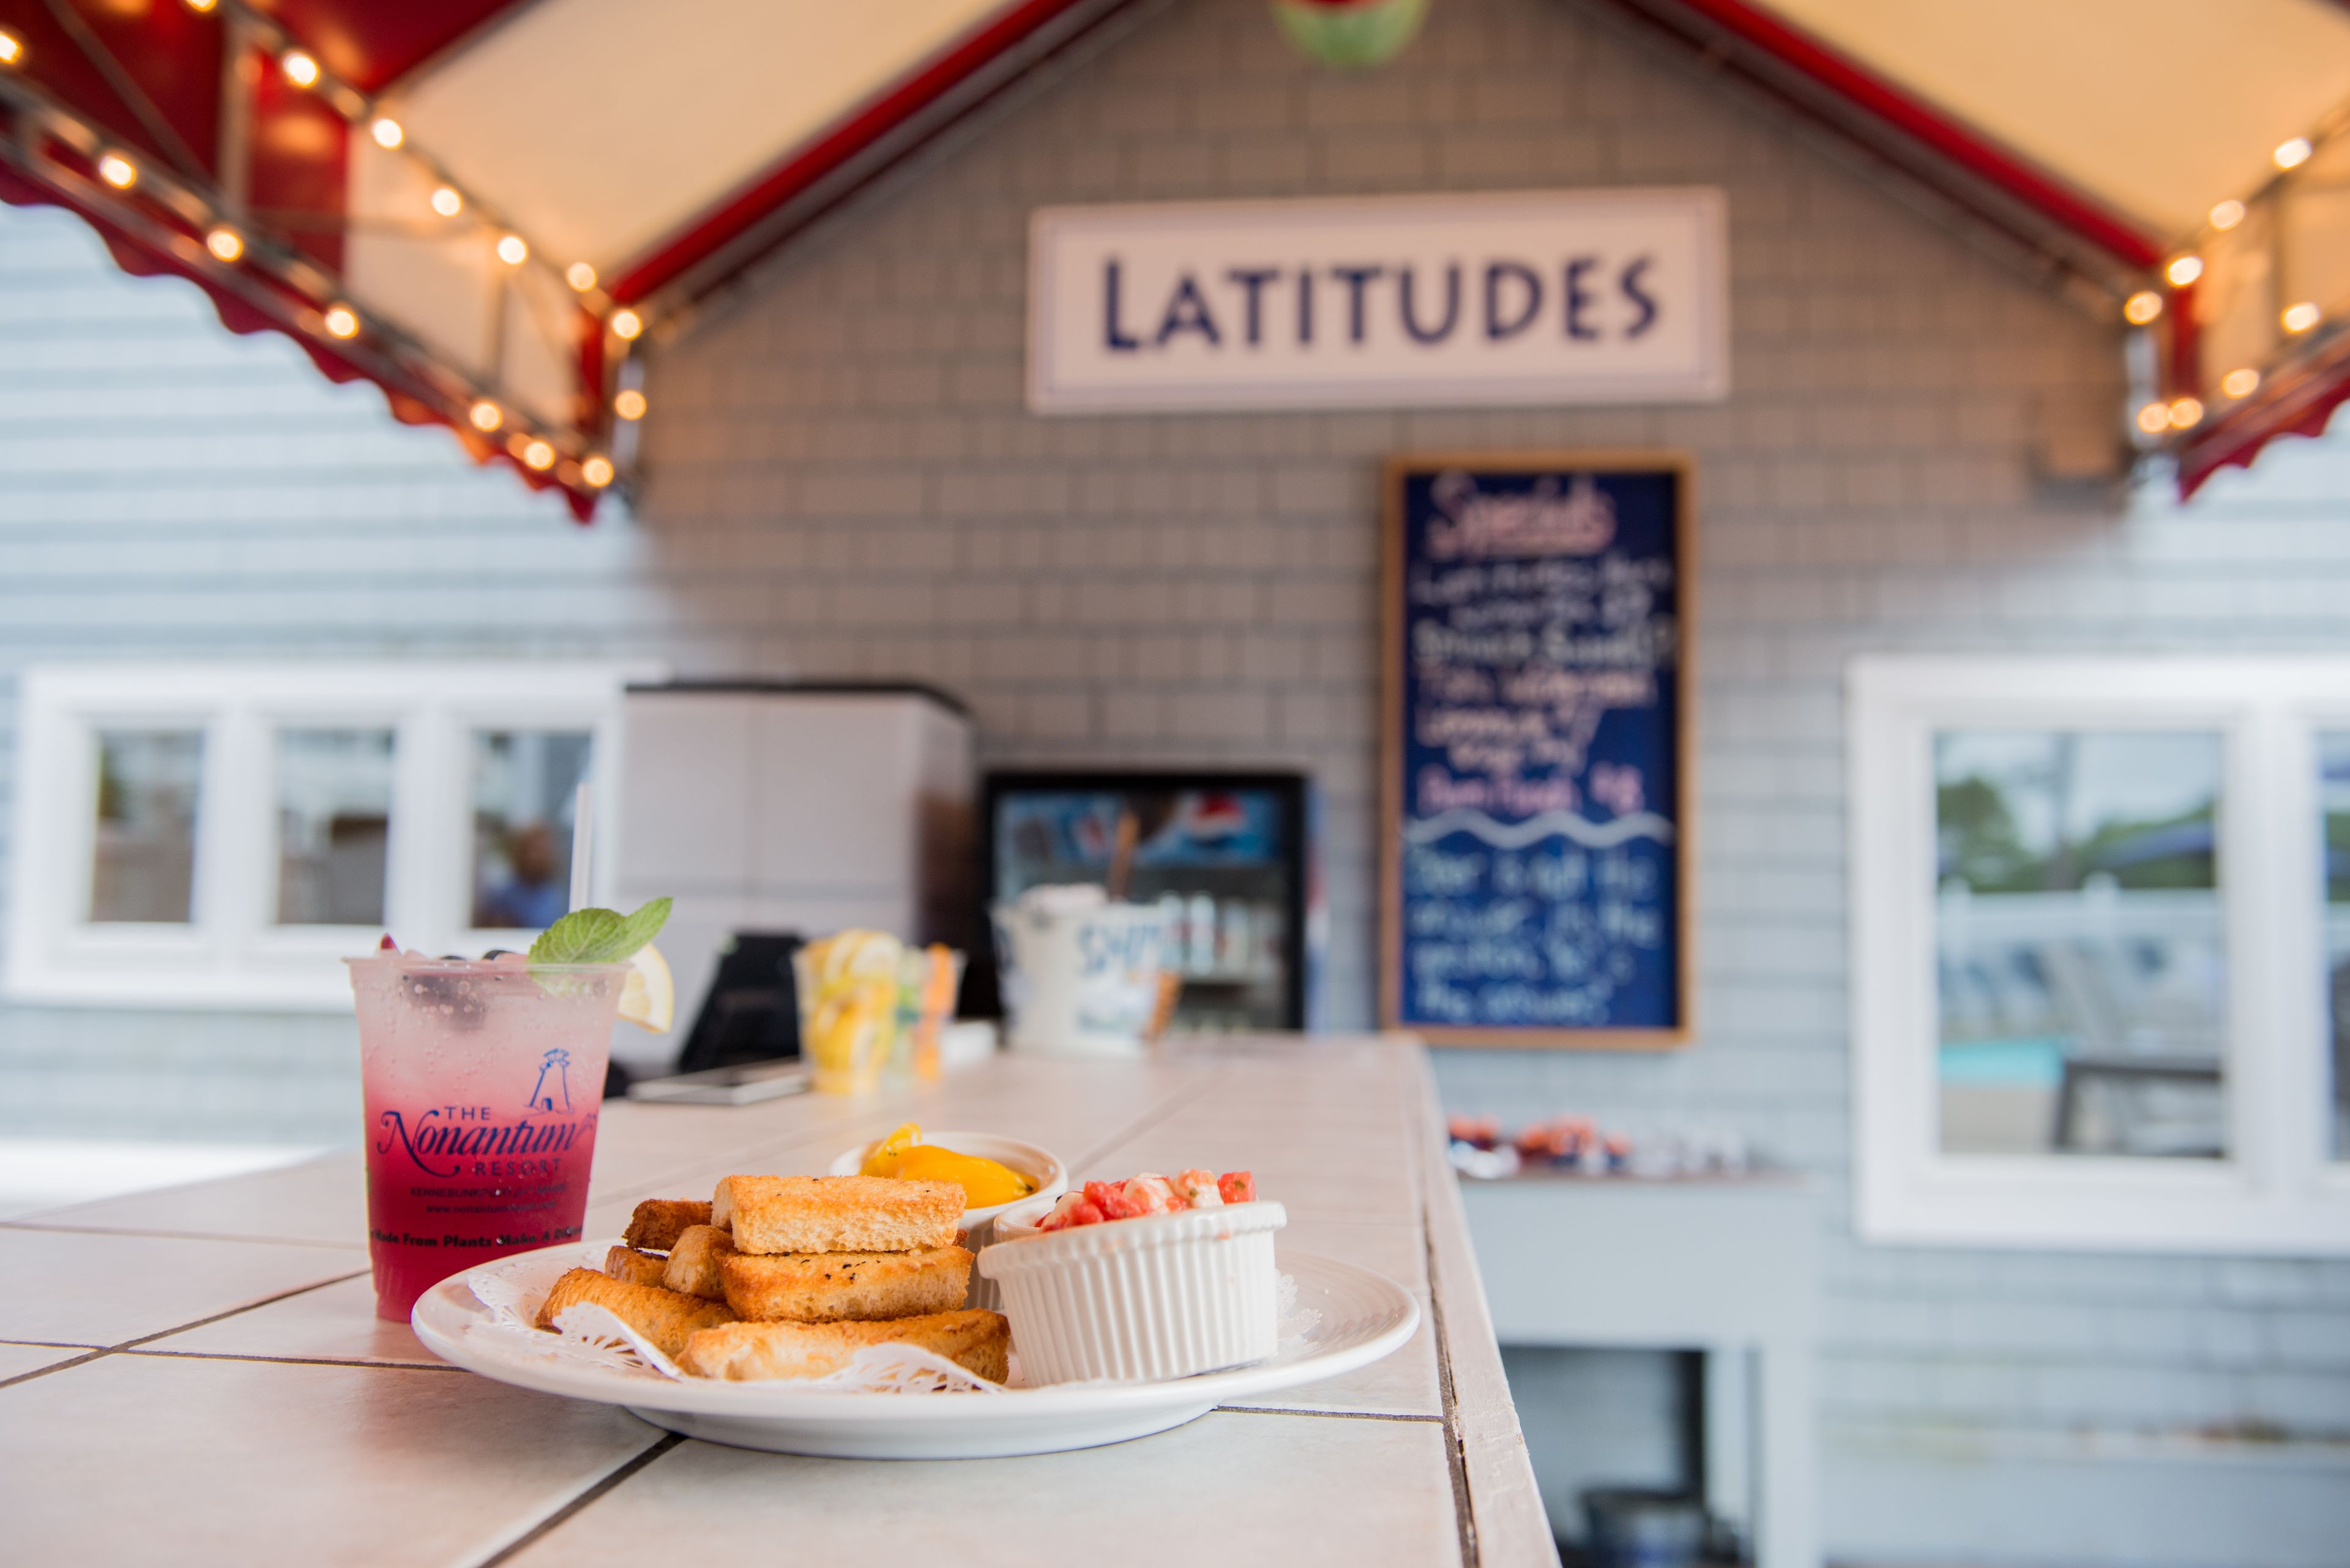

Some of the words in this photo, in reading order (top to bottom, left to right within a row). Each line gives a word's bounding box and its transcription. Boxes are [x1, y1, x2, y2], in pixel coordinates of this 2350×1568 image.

[1102, 253, 1660, 353] LATITUDES
[444, 1106, 490, 1120] THE
[377, 1109, 585, 1178] Nonantum
[475, 1157, 561, 1177] RESORT
[403, 1233, 438, 1247] From
[442, 1233, 492, 1247] Plants
[496, 1230, 537, 1245] Make
